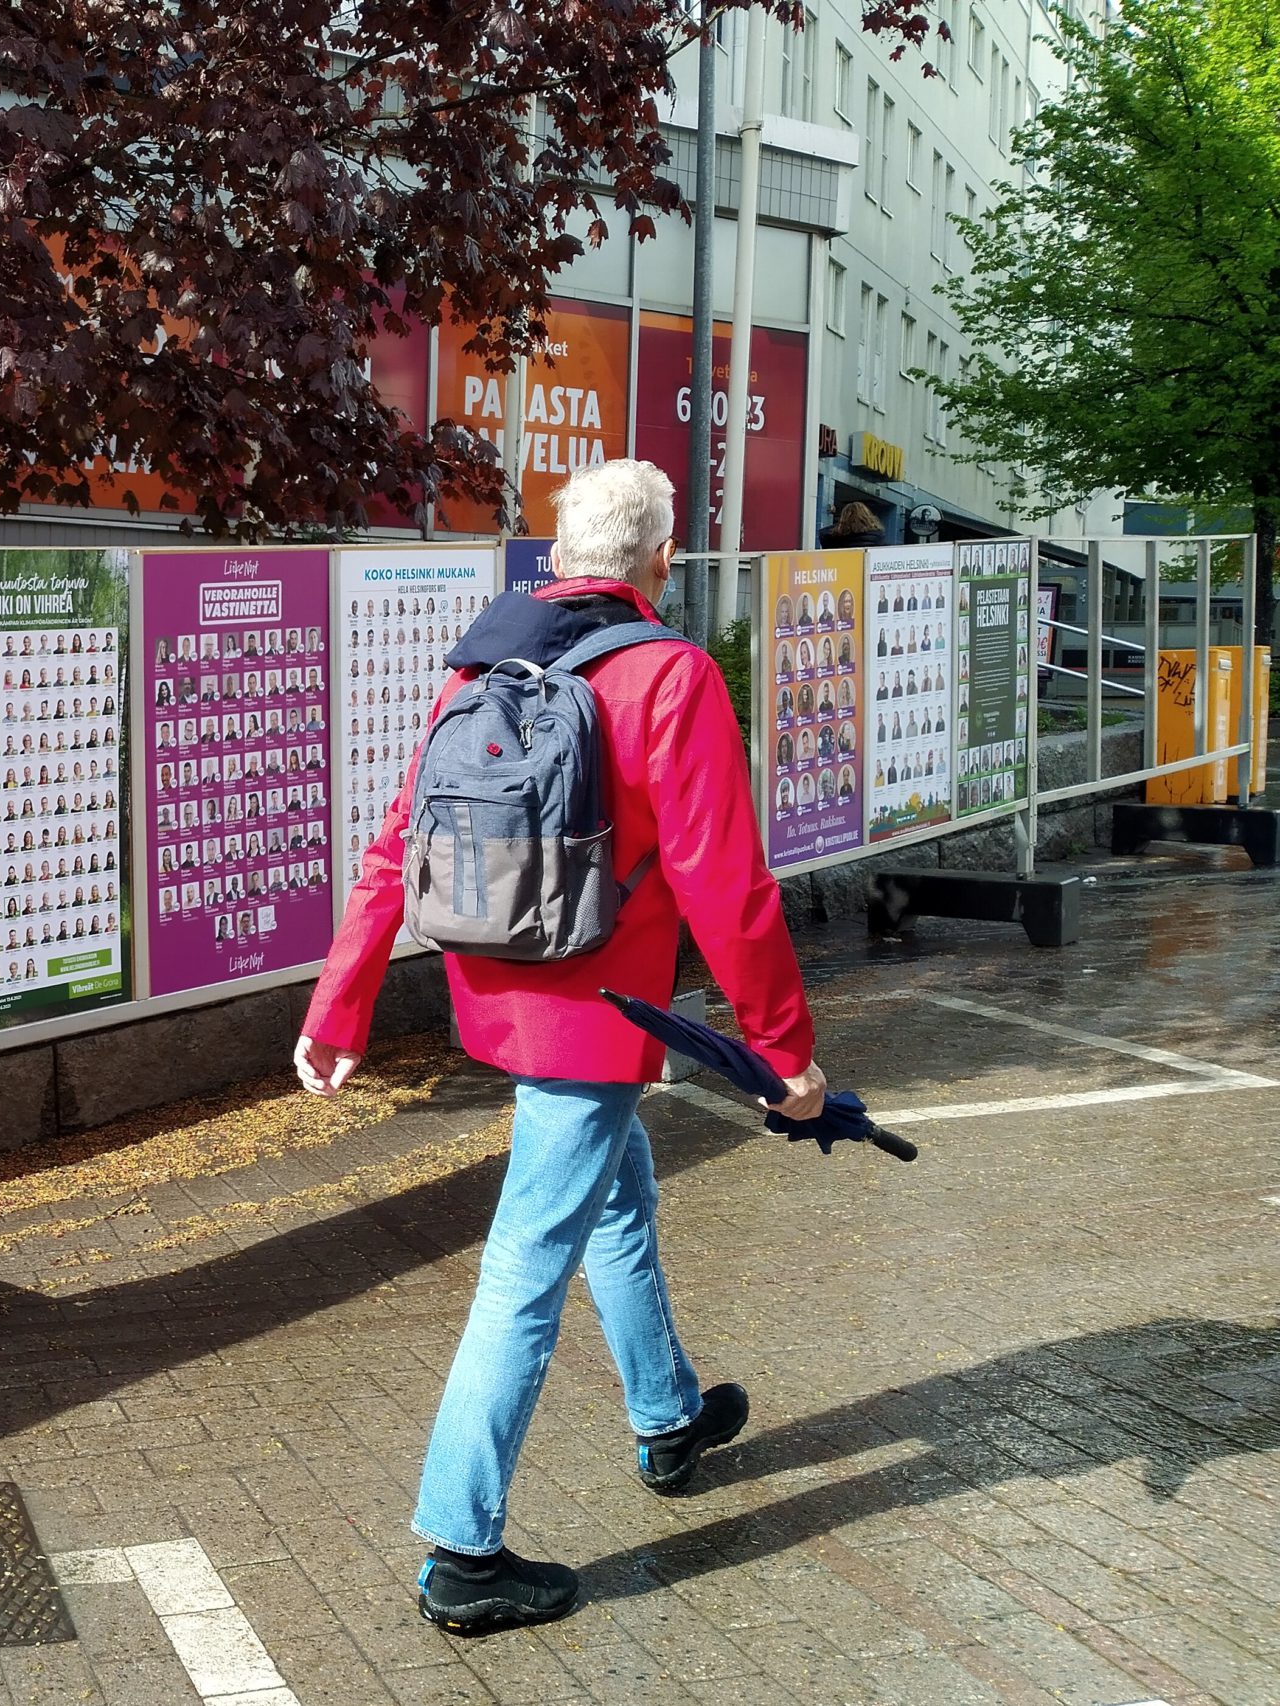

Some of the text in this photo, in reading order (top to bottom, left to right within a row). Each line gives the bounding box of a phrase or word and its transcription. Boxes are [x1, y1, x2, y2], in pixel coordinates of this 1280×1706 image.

[464, 376, 602, 429] PAASTA
[364, 566, 476, 581] KOKO HELSINKI MUKANA
[794, 567, 837, 585] HELSINKI
[50, 572, 89, 600] torjuva
[204, 587, 278, 601] VERORAHOILLE
[15, 595, 31, 615] ON
[34, 591, 74, 614] VIHREÄ
[977, 588, 1010, 605] PELASTETAAN
[203, 600, 278, 618] VASTINETTA
[976, 604, 1009, 628] HELSINKI
[72, 983, 94, 993] Vihreät
